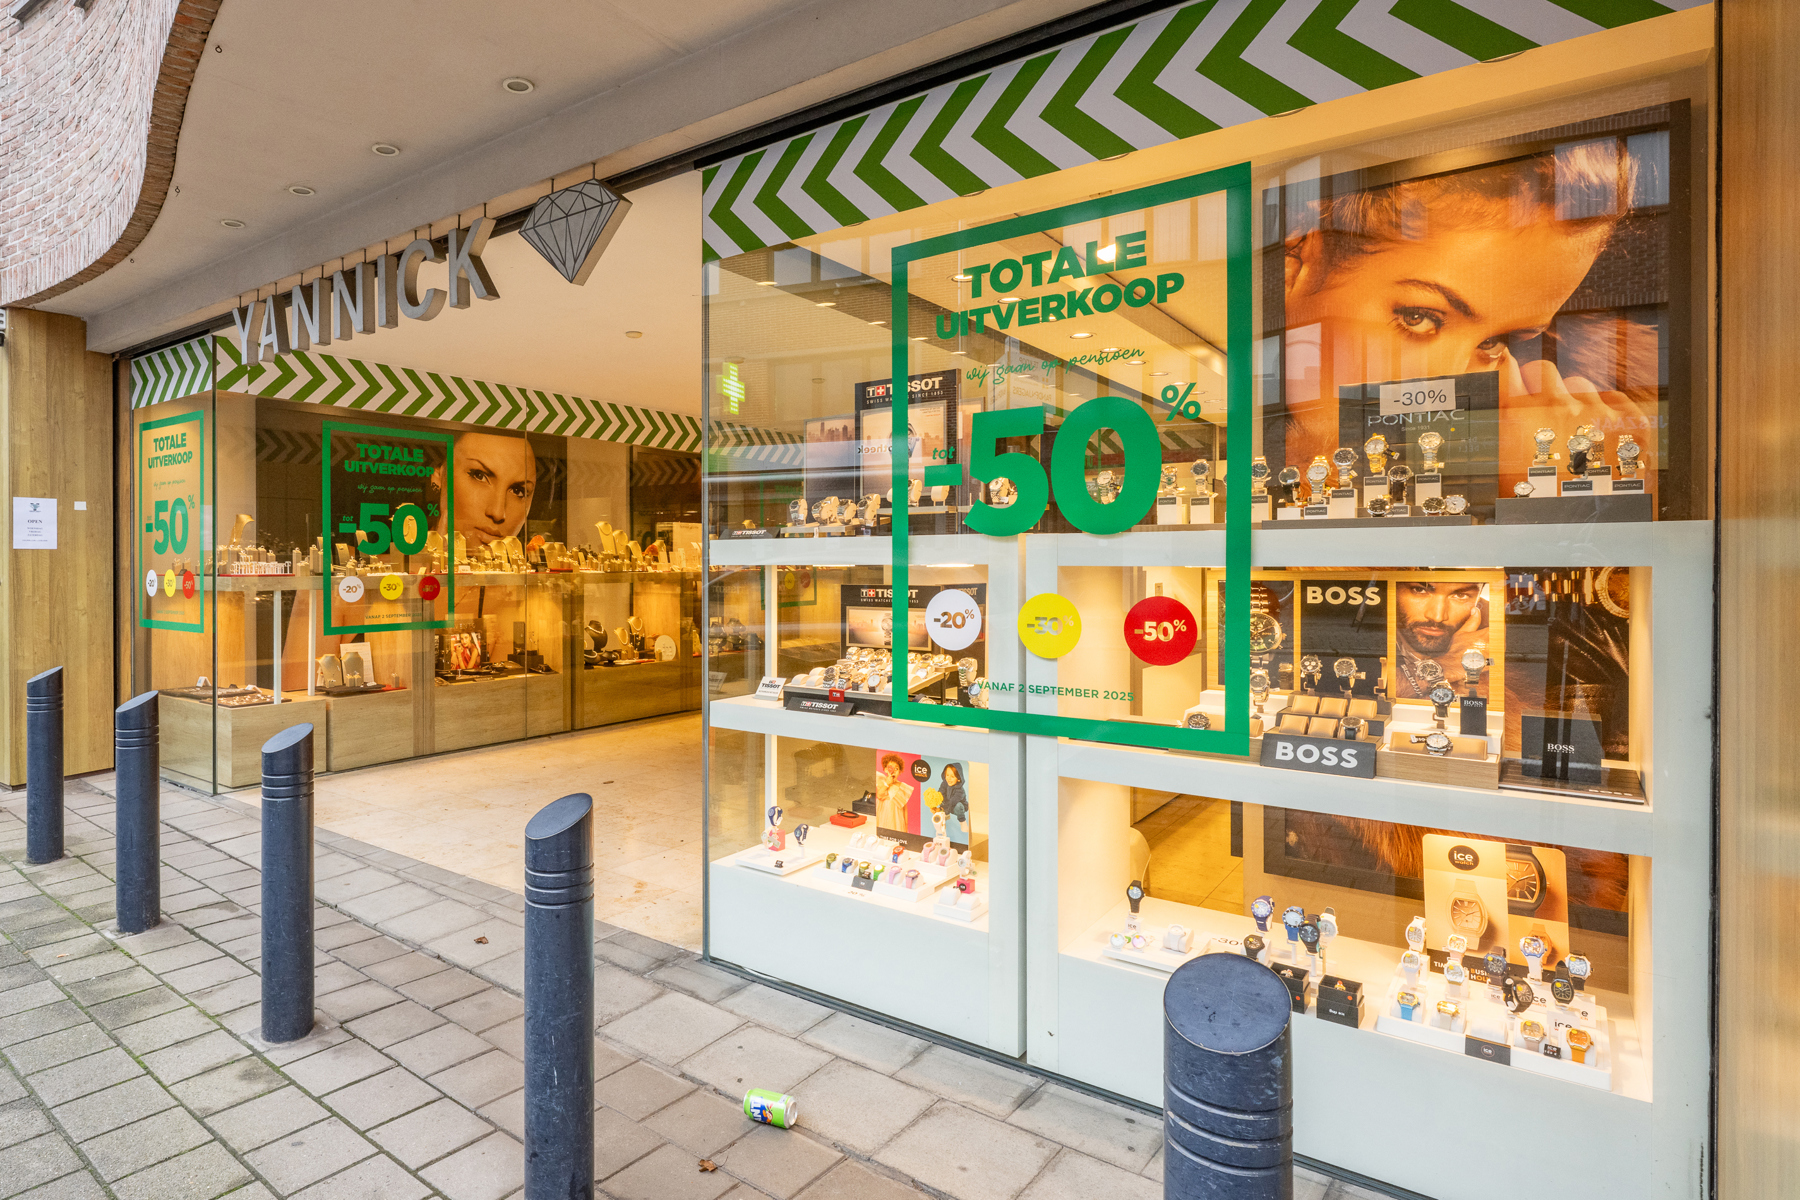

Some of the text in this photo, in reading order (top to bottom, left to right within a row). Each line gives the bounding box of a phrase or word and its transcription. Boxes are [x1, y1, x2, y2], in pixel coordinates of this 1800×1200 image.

[963, 230, 1147, 299] TOTALE
[232, 216, 500, 366] YANNICK
[936, 272, 1185, 340] UITVERKOOP
[966, 366, 990, 388] wij
[993, 362, 1035, 385] gaan
[1041, 358, 1062, 377] op
[1065, 348, 1146, 374] pensioen
[1393, 389, 1447, 406] -30%
[1367, 408, 1465, 427] PONTIAC
[153, 432, 187, 453] TOTALE
[148, 450, 193, 469] UITVERKOOP
[356, 443, 424, 463] TOTALE
[932, 446, 955, 460] tot
[344, 460, 435, 477] UITVERKOOP
[339, 503, 440, 556] -50%
[1306, 586, 1381, 606] BOSS
[934, 608, 975, 630] -20%
[1027, 615, 1074, 636] -30%
[1134, 620, 1187, 642] -50%
[978, 680, 1134, 702] VANAF 2 SEPTEMBER 2025
[811, 701, 839, 710] TISSOT
[1275, 741, 1358, 769] BOSS
[1547, 742, 1575, 752] BOSS
[914, 764, 928, 774] ice
[1454, 850, 1474, 861] ice
